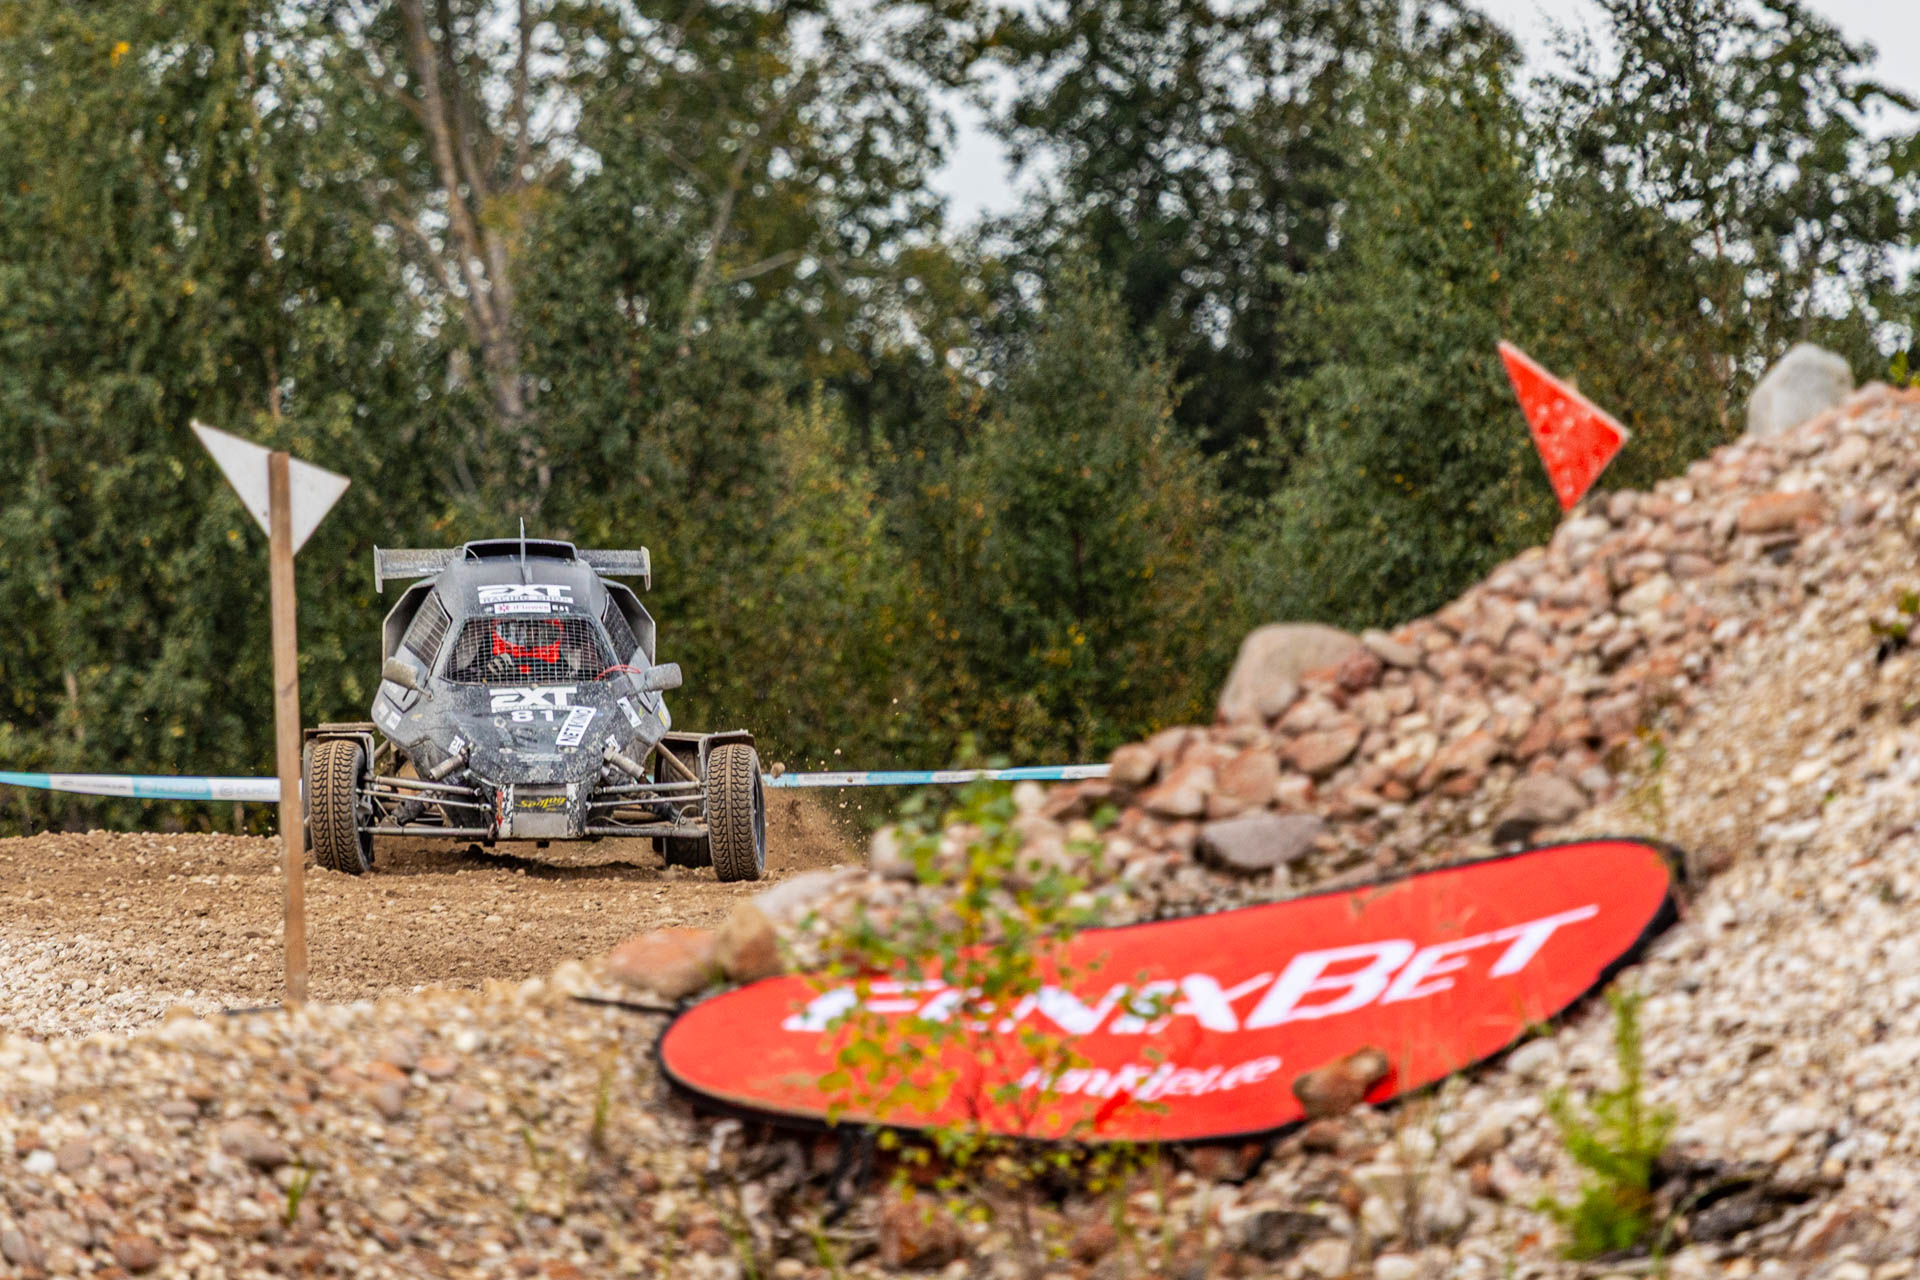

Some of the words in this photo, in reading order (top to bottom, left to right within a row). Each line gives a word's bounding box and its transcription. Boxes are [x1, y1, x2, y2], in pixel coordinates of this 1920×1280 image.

[477, 584, 571, 598] 2XT
[489, 686, 577, 707] 2XT
[511, 710, 554, 722] 81
